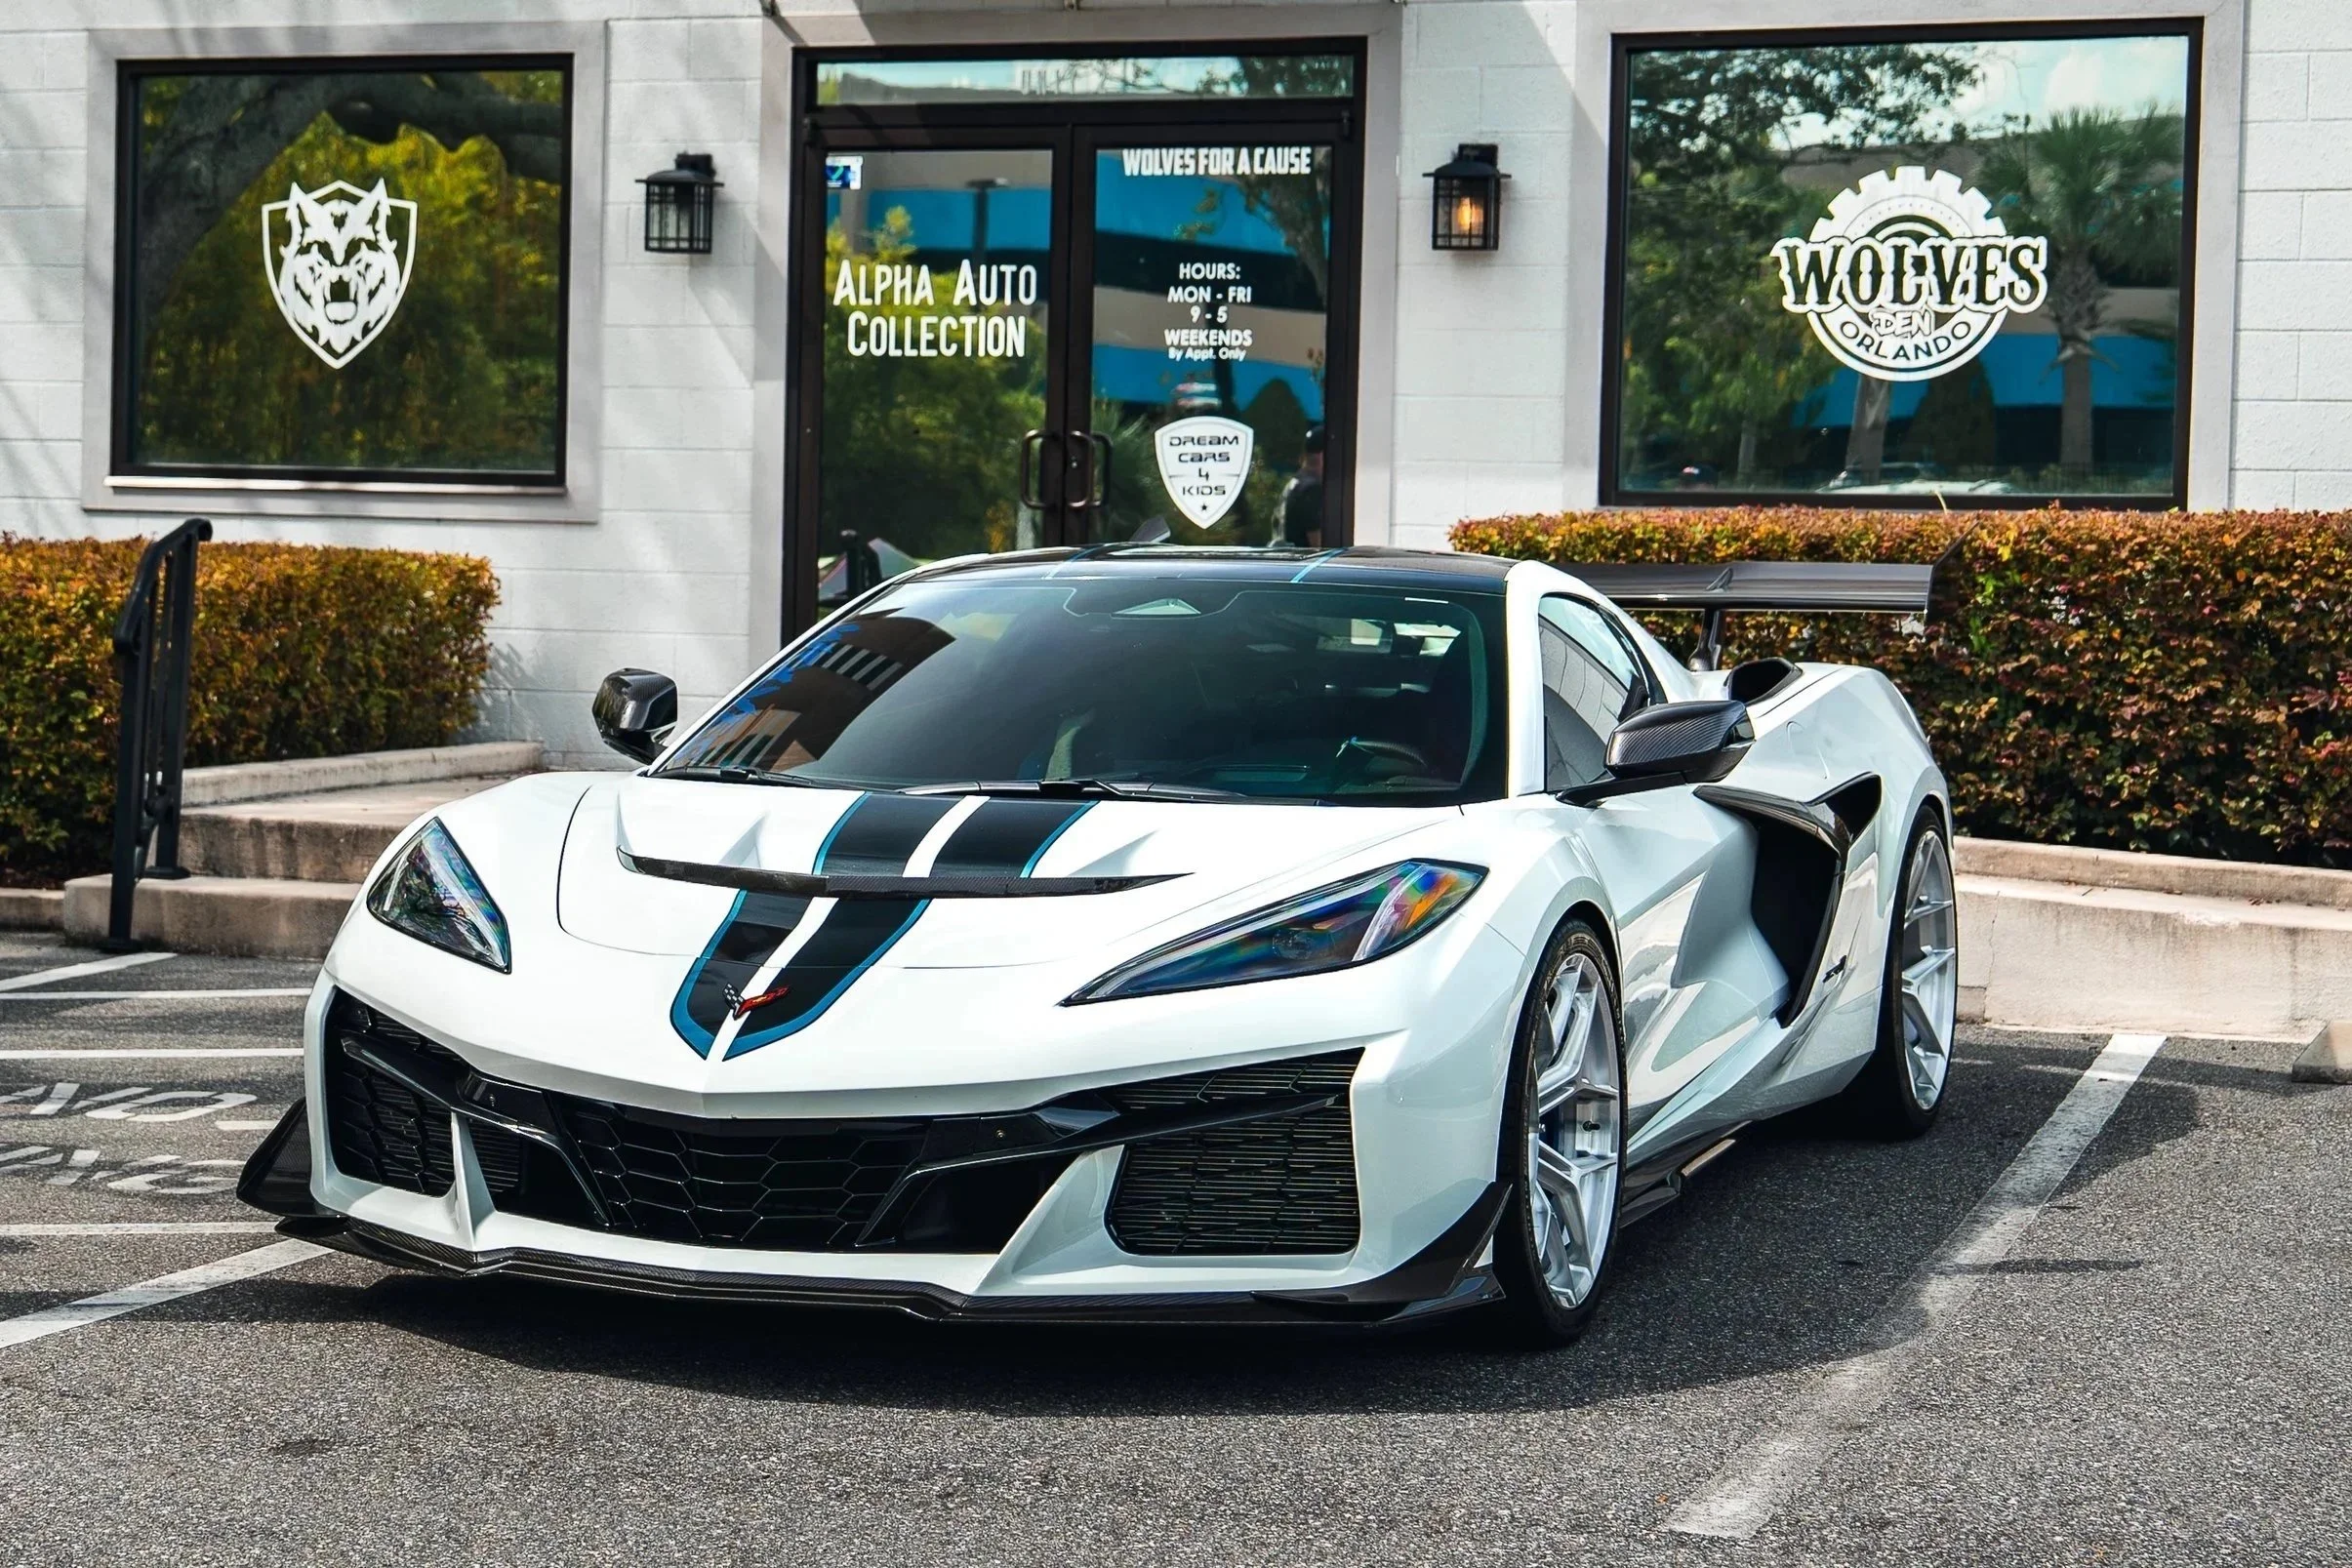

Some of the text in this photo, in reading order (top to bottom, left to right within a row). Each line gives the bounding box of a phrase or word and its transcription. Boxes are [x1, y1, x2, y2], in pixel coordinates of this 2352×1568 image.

[1122, 147, 1312, 177] WOLVES FOR A CAUSE
[1179, 262, 1241, 280] HOURS:
[1780, 243, 2042, 306] WOLVES
[832, 259, 1037, 306] ALPHA AUTO
[1167, 286, 1211, 303] MON
[1228, 286, 1252, 303] FRI
[1190, 304, 1201, 323] 9
[1216, 305, 1228, 323] 5
[1872, 308, 1933, 339] DEN
[847, 310, 1025, 357] COLLECTION
[1164, 329, 1253, 346] WEEKENDS
[1840, 321, 1971, 361] ORLANDO
[1168, 346, 1183, 362] By
[1218, 346, 1246, 362] Only
[1198, 467, 1209, 481] 4
[1182, 485, 1226, 497] KIDS
